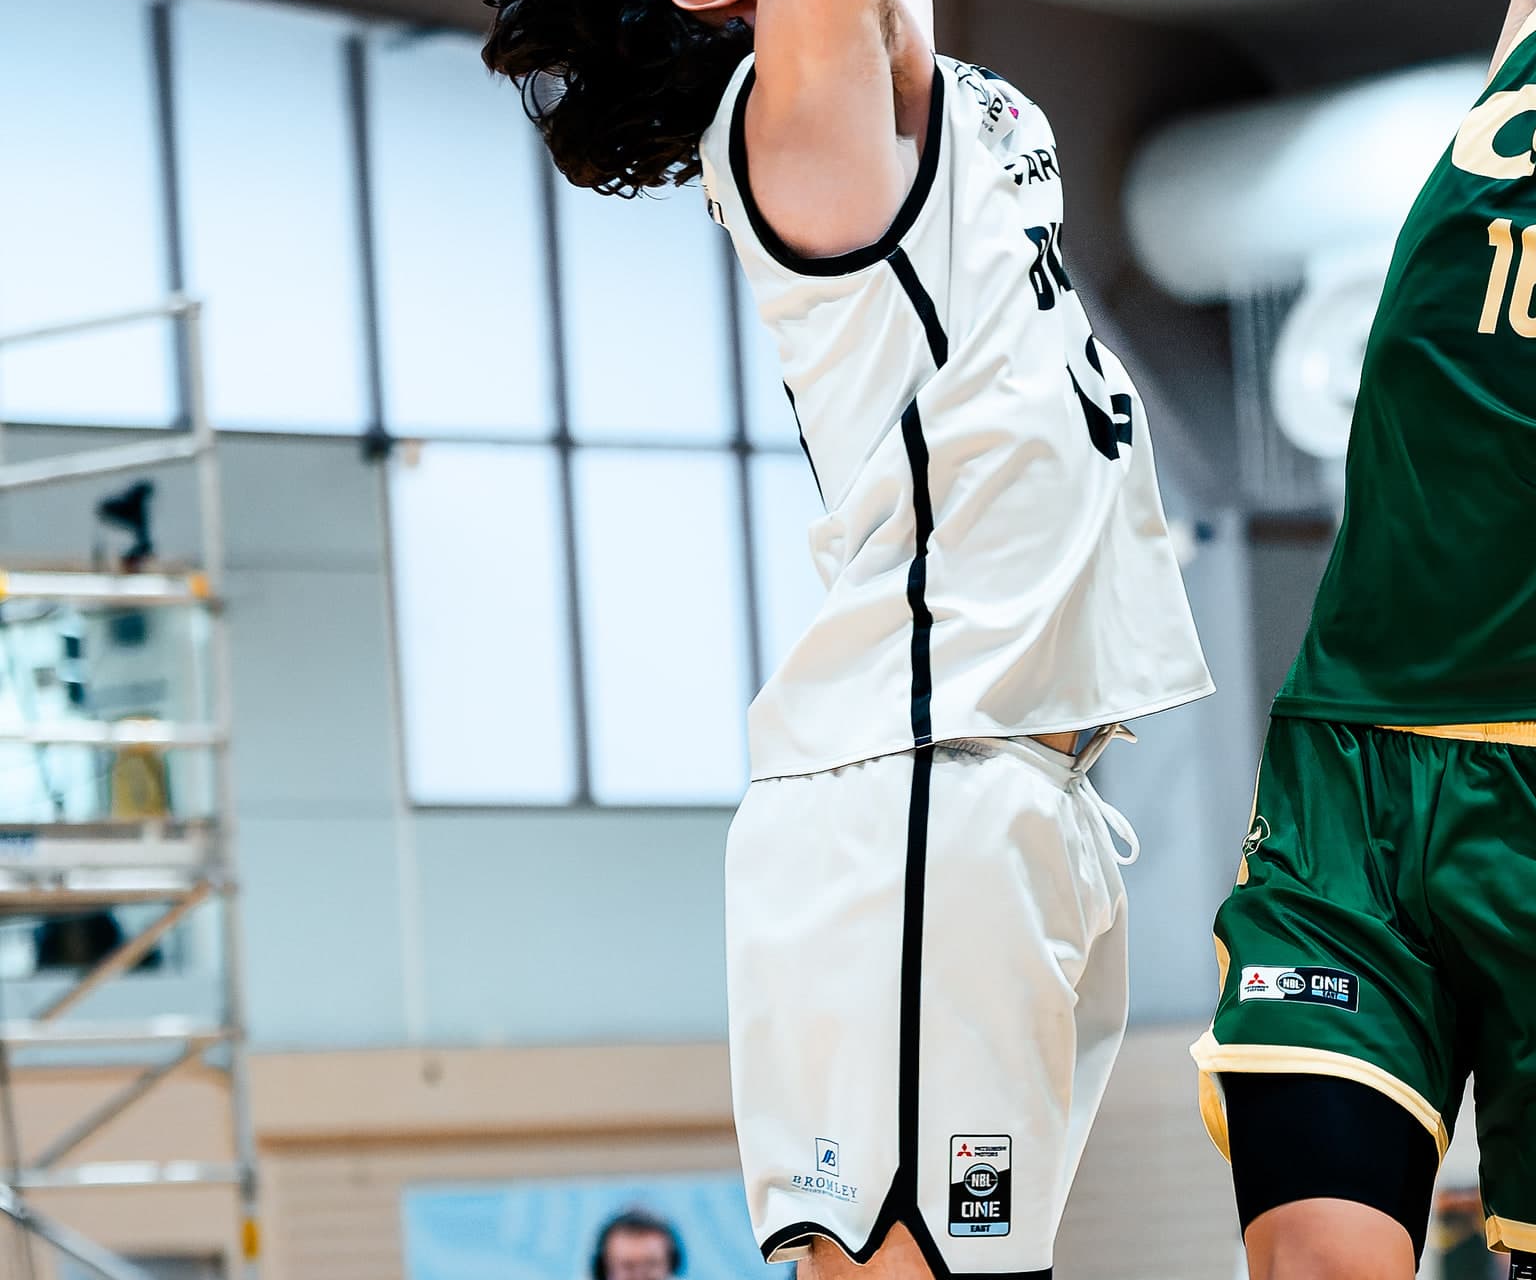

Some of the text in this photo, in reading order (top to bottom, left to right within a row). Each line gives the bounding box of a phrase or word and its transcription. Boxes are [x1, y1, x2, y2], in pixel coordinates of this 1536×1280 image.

[1311, 975, 1350, 994] ONE
[792, 1175, 858, 1198] BROMLEY
[971, 1173, 992, 1187] NBL
[961, 1201, 1001, 1218] ONE
